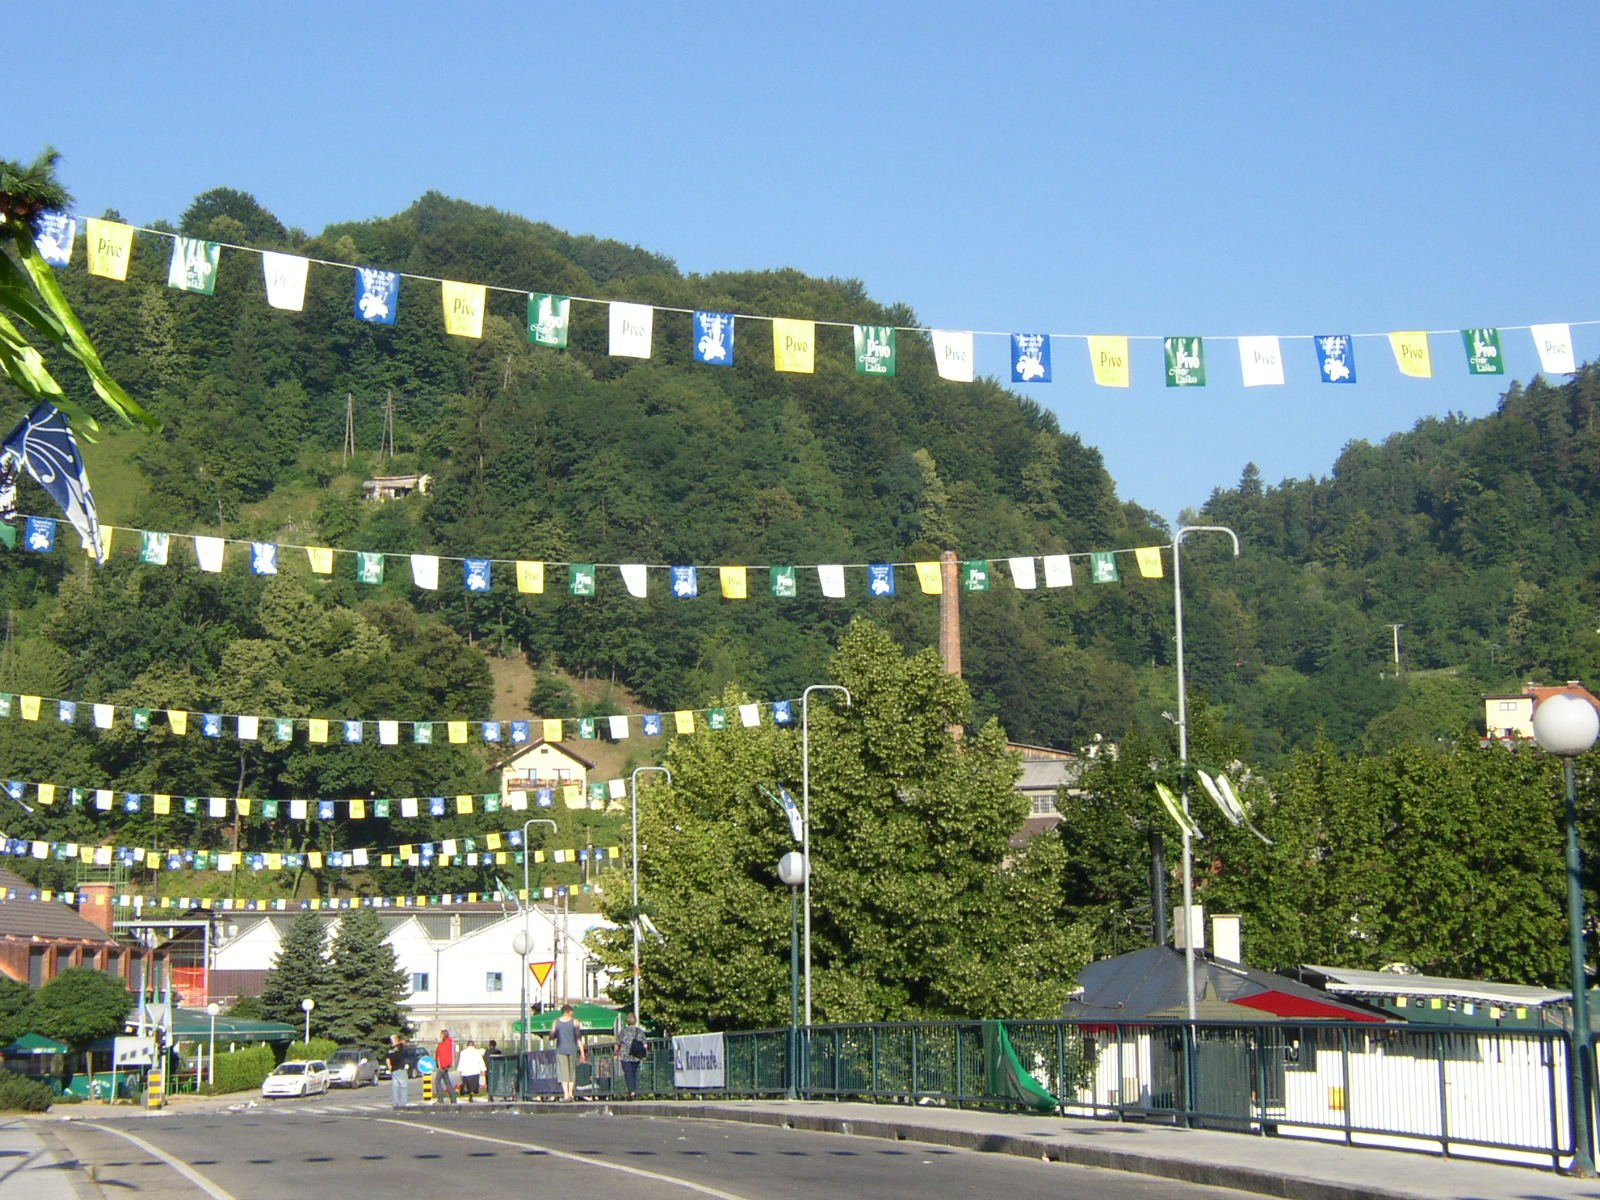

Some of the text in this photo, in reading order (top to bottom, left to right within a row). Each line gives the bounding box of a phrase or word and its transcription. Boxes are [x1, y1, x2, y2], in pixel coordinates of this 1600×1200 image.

[785, 335, 808, 353] Pivo
[1401, 344, 1424, 359] Pivo
[1100, 351, 1122, 368] Pivo
